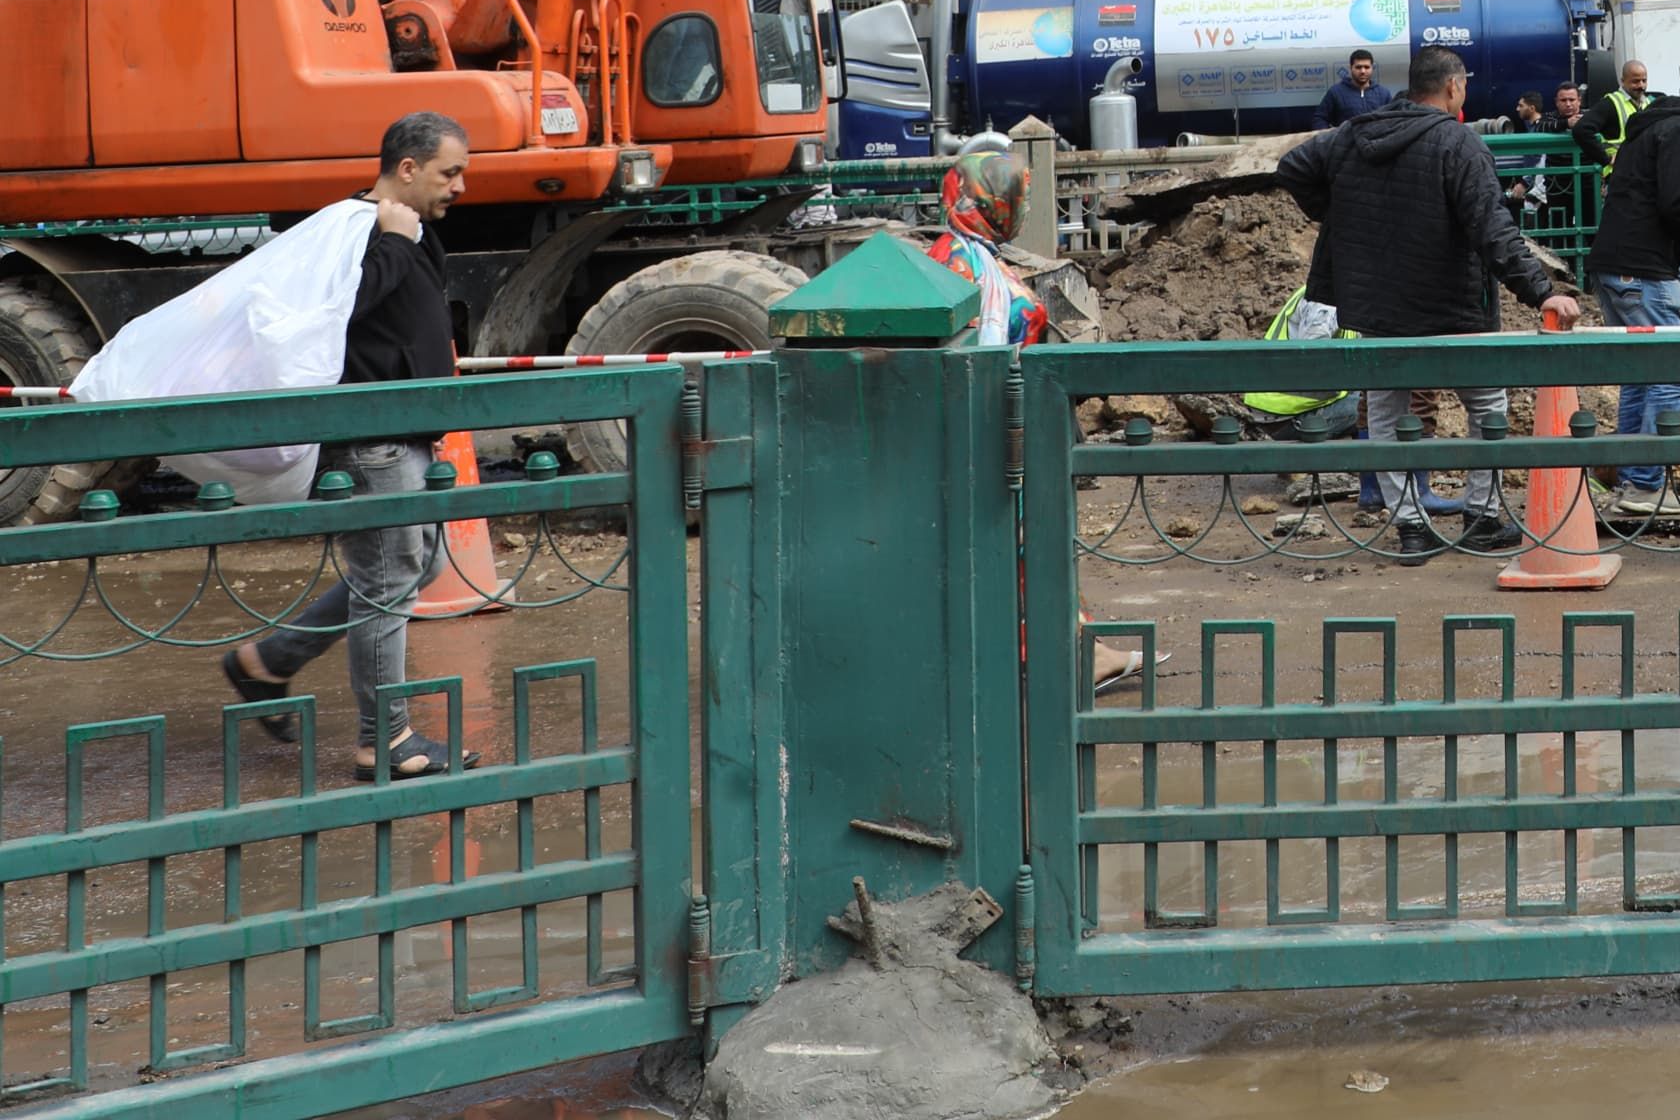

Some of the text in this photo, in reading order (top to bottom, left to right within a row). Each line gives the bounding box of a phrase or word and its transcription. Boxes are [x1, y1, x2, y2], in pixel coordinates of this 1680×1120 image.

[324, 22, 367, 33] DAEWOO
[1437, 26, 1470, 40] Tetra
[1108, 35, 1141, 51] Tetra
[1193, 27, 1318, 49] الخط الساخن ١٧٥
